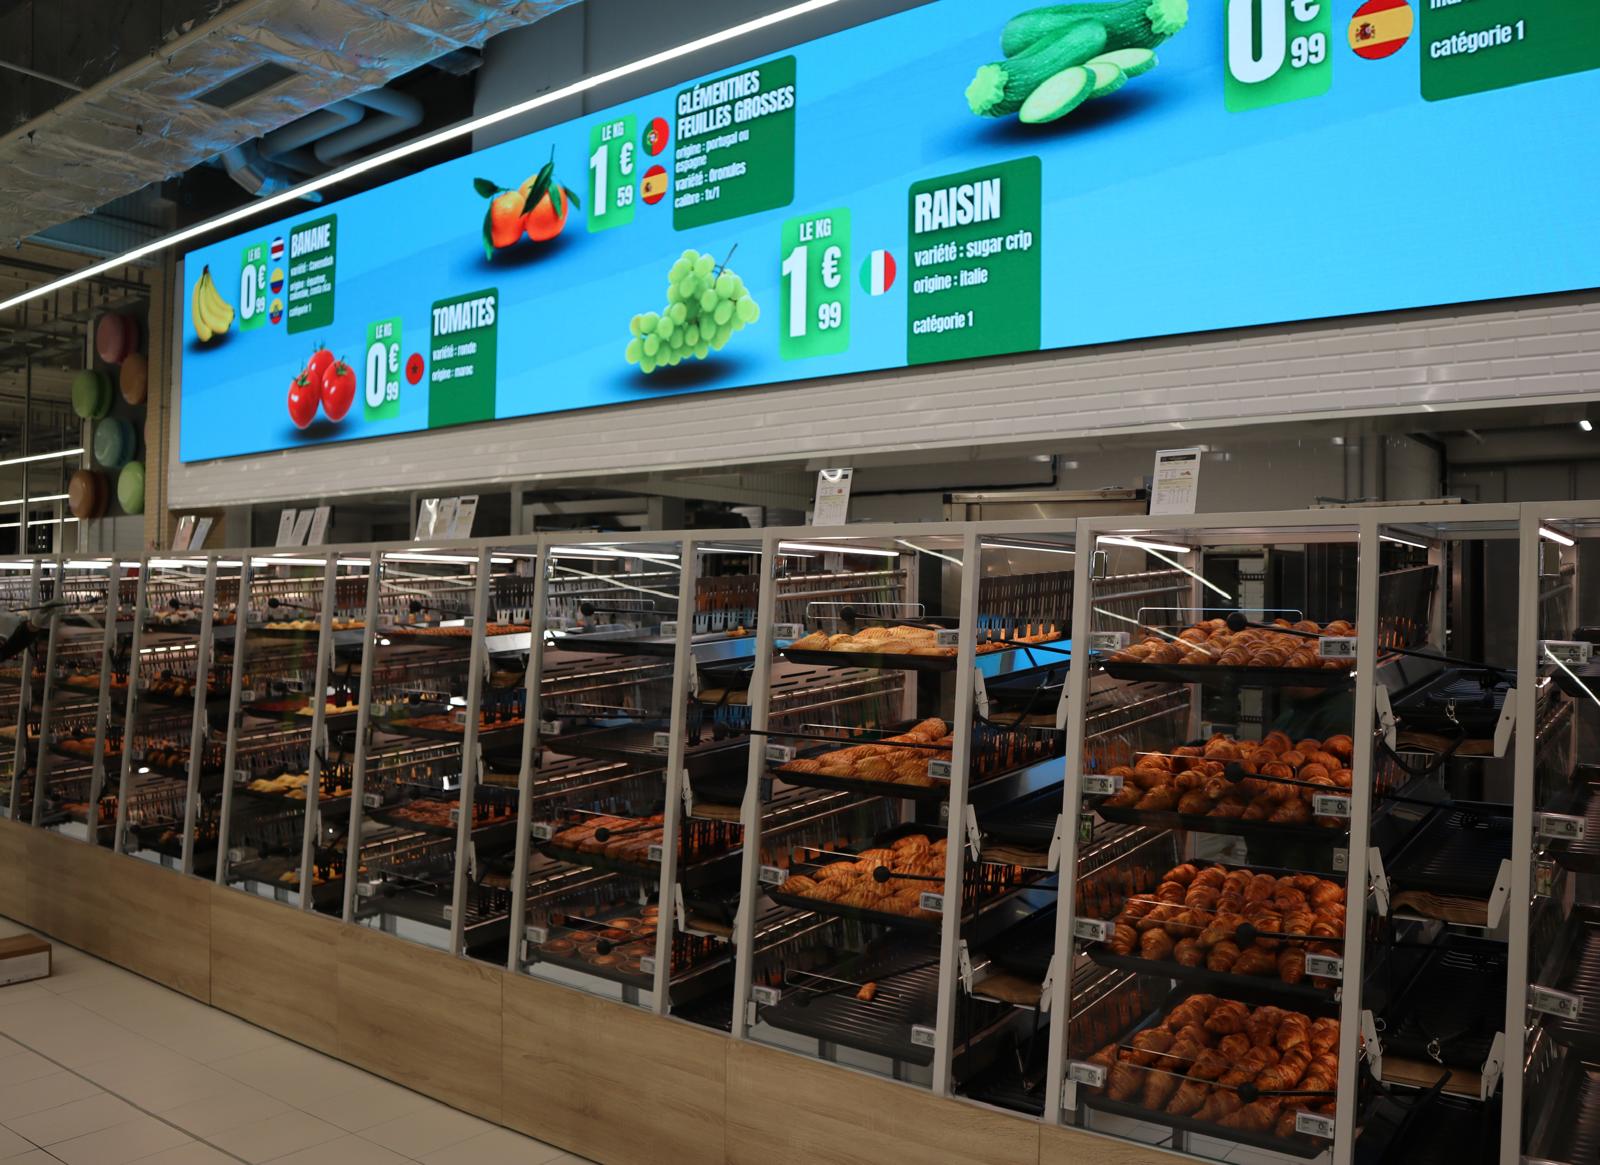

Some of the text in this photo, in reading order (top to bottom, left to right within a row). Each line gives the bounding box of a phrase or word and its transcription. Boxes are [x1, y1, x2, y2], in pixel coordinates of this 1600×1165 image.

[1228, 0, 1286, 83] 0
[1290, 32, 1326, 68] 99
[1430, 19, 1524, 58] catégorie 1
[677, 85, 794, 140] FEUILLES GROSSES
[602, 121, 624, 141] LE KG
[676, 144, 701, 159] origine
[706, 131, 738, 153] portugal
[590, 142, 634, 216] 1 €
[675, 171, 704, 191] variété
[676, 154, 707, 173] espagne
[617, 185, 633, 207] 59
[914, 177, 1001, 234] RAISIN
[291, 223, 331, 258] BANANE
[800, 218, 832, 242] LE KG
[914, 242, 957, 267] variété
[966, 236, 1003, 258] sugar
[1005, 229, 1033, 251] crip
[241, 264, 266, 319] 0 €
[782, 245, 842, 337] 1 €
[913, 273, 952, 294] origine
[376, 325, 384, 339] LE
[433, 296, 495, 336] TOMATES
[818, 302, 842, 330] 99
[913, 310, 974, 335] catégorie 1
[366, 342, 399, 407] 0 €
[387, 381, 399, 401] 99
